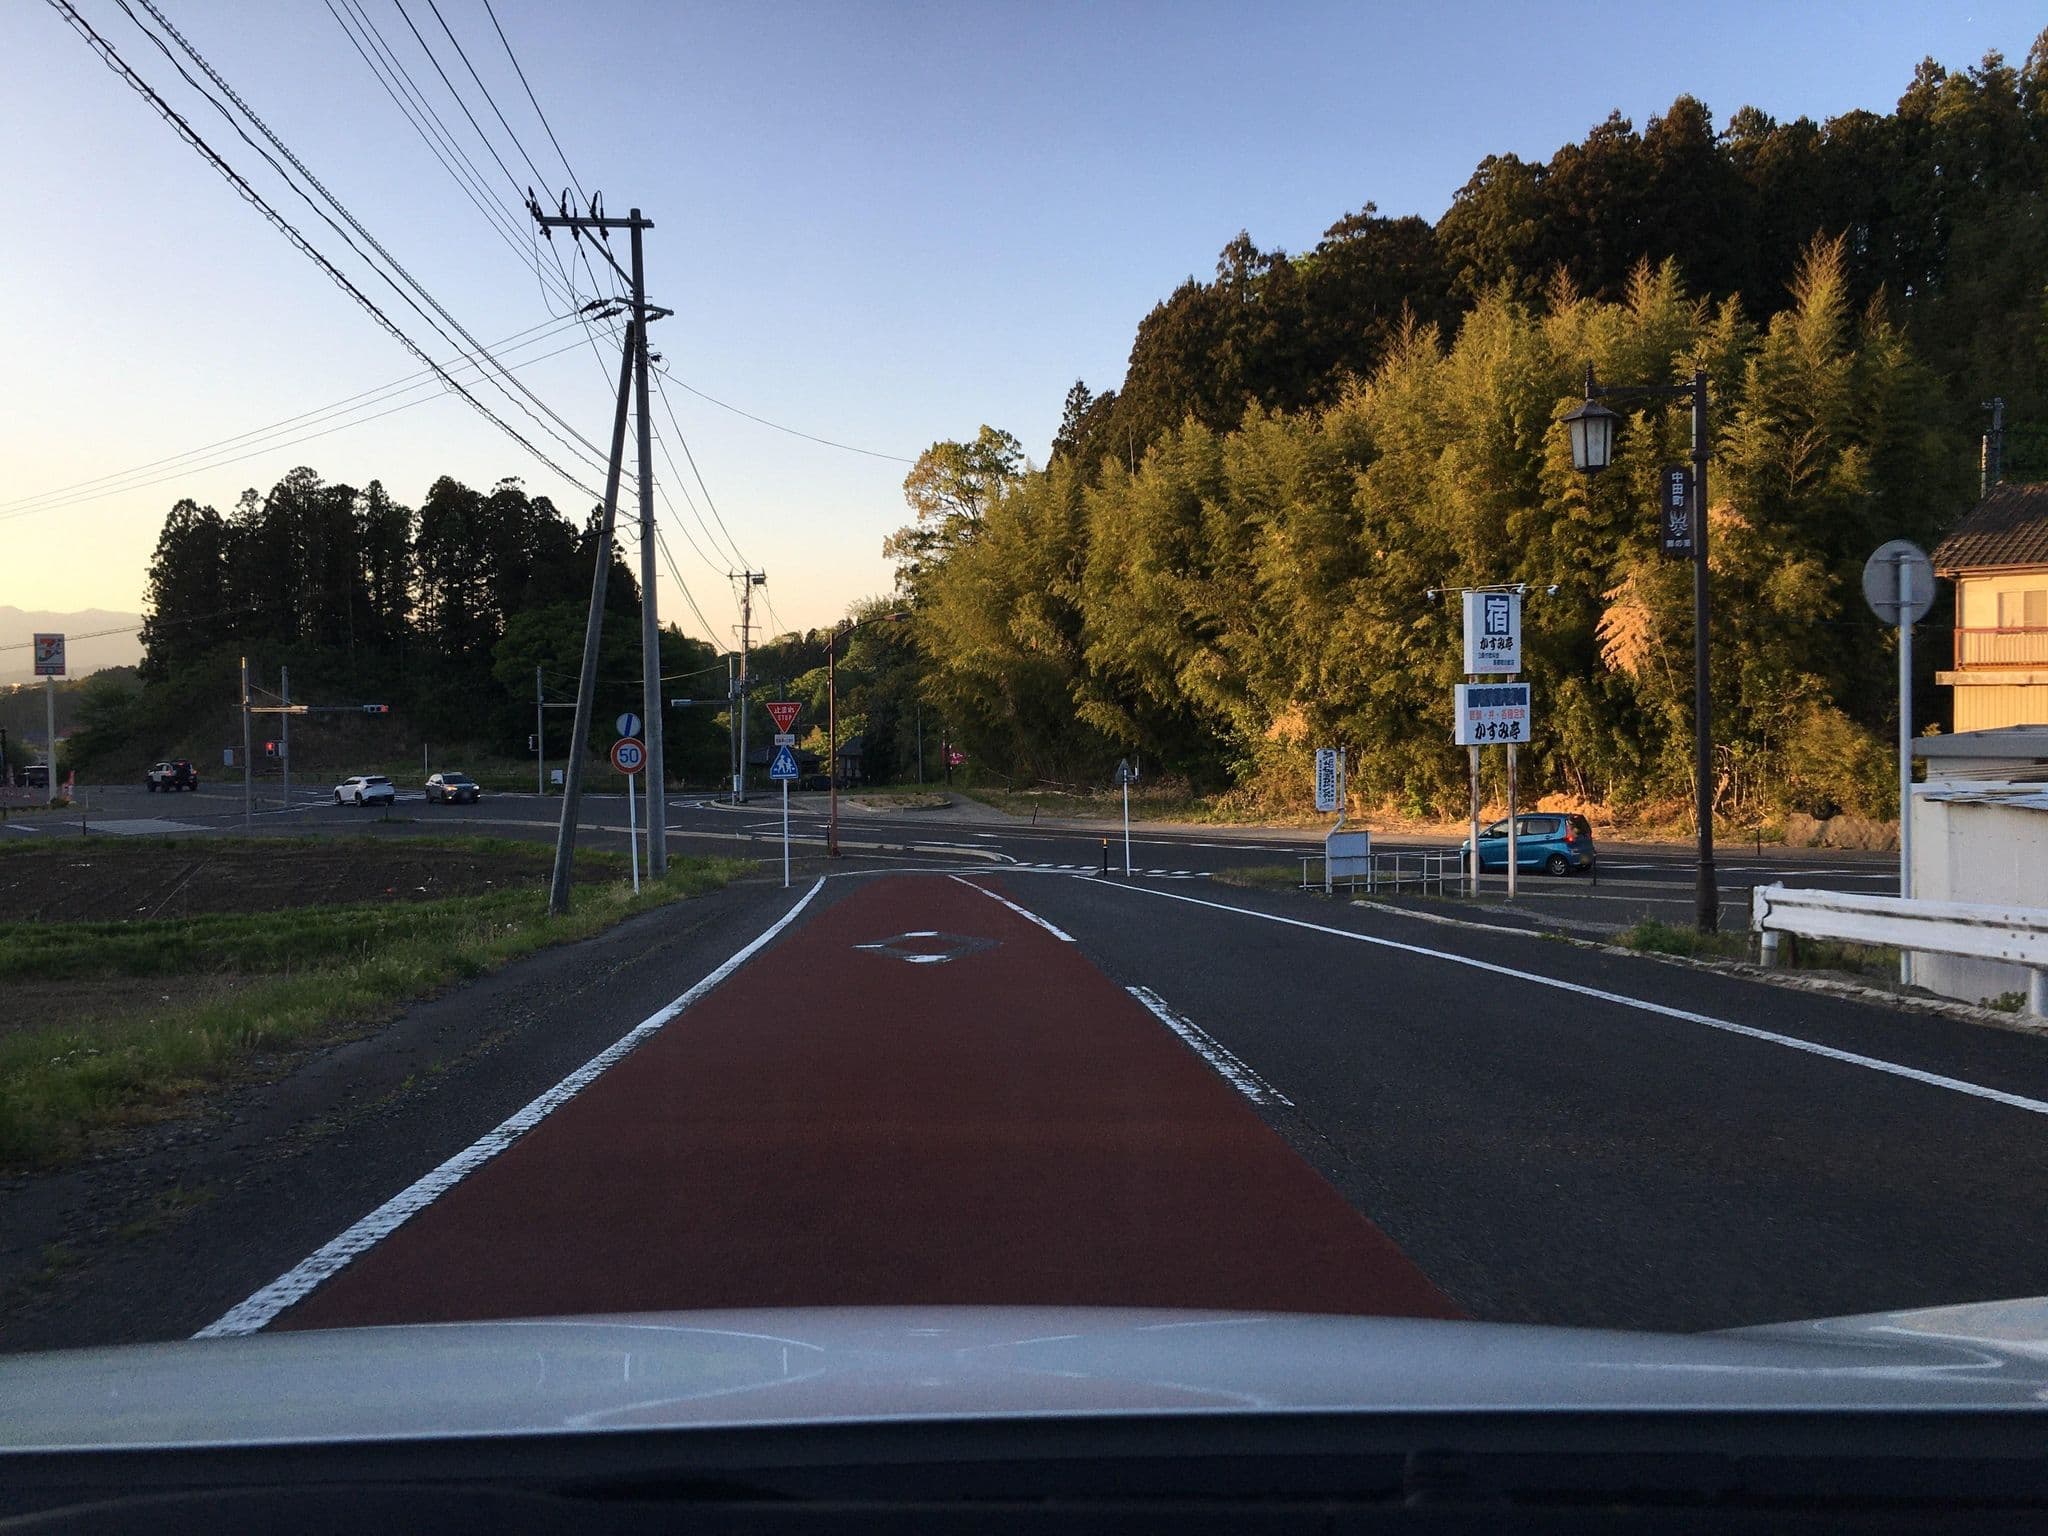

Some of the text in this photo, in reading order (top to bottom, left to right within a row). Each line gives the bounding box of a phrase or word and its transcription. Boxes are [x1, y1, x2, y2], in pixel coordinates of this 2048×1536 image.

[1671, 471, 1684, 507] 中田町
[1487, 598, 1508, 632] 宿
[1480, 637, 1514, 650] かすみ亭
[774, 706, 795, 714] 止まれ
[1475, 720, 1521, 740] かすみ亭
[620, 748, 639, 763] 50
